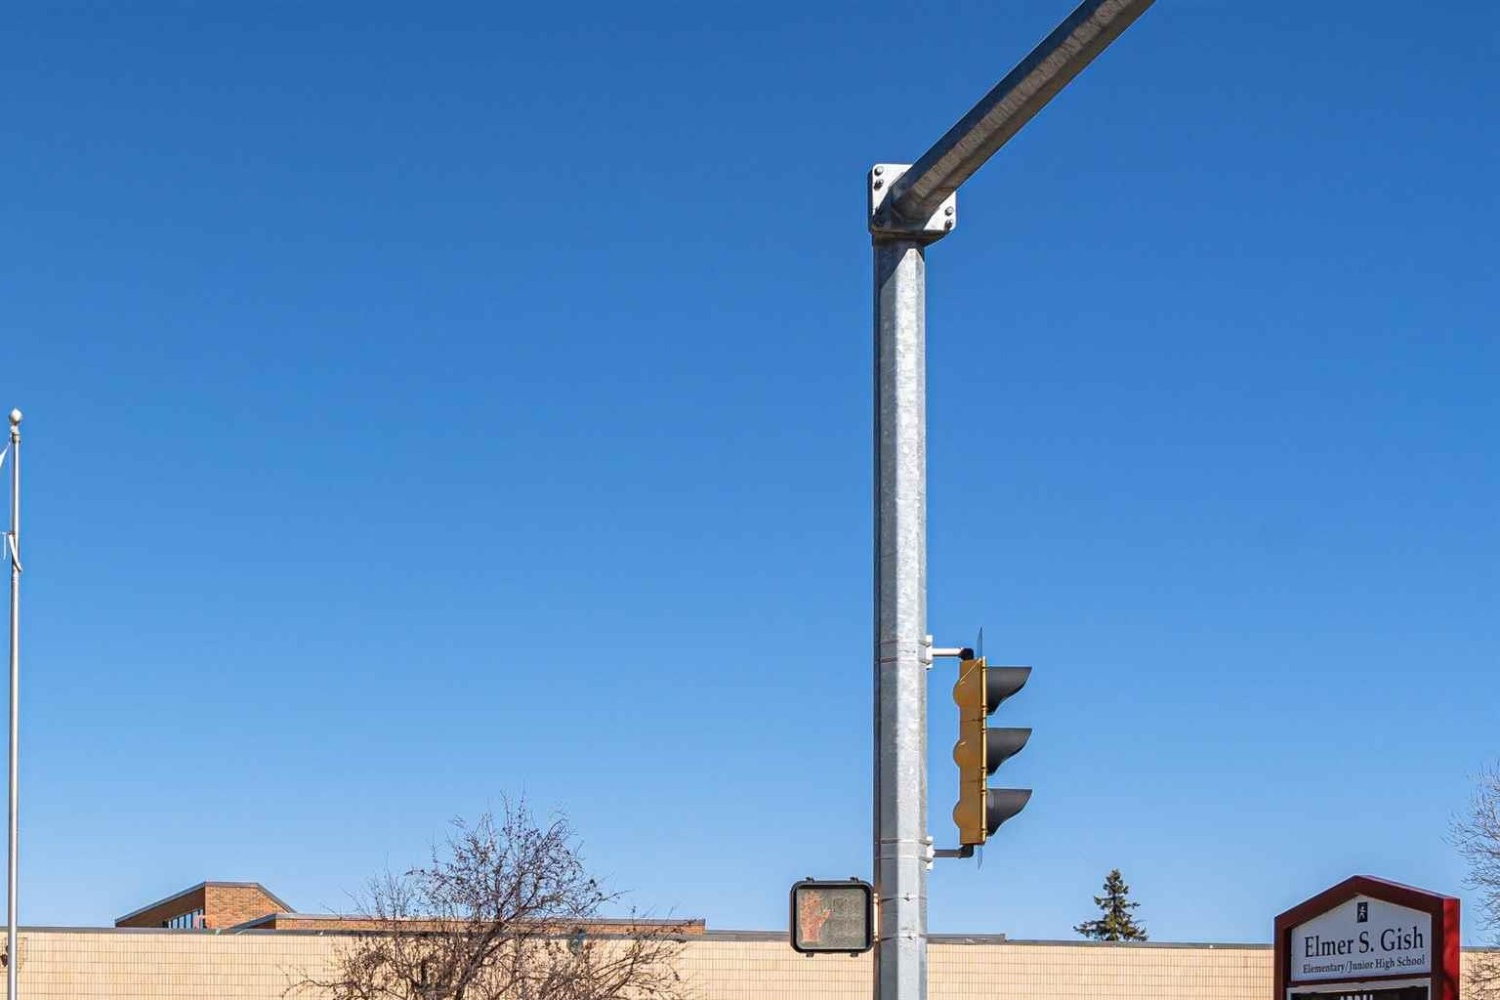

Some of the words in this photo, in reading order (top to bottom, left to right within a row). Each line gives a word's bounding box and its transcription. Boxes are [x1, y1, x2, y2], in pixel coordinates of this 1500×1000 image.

[1304, 935, 1354, 957] Elmer
[1358, 931, 1374, 953] S.
[1381, 926, 1424, 951] Gish
[1303, 960, 1374, 974] Elementary/Junior
[1375, 957, 1395, 971] High
[1397, 954, 1425, 967] School
